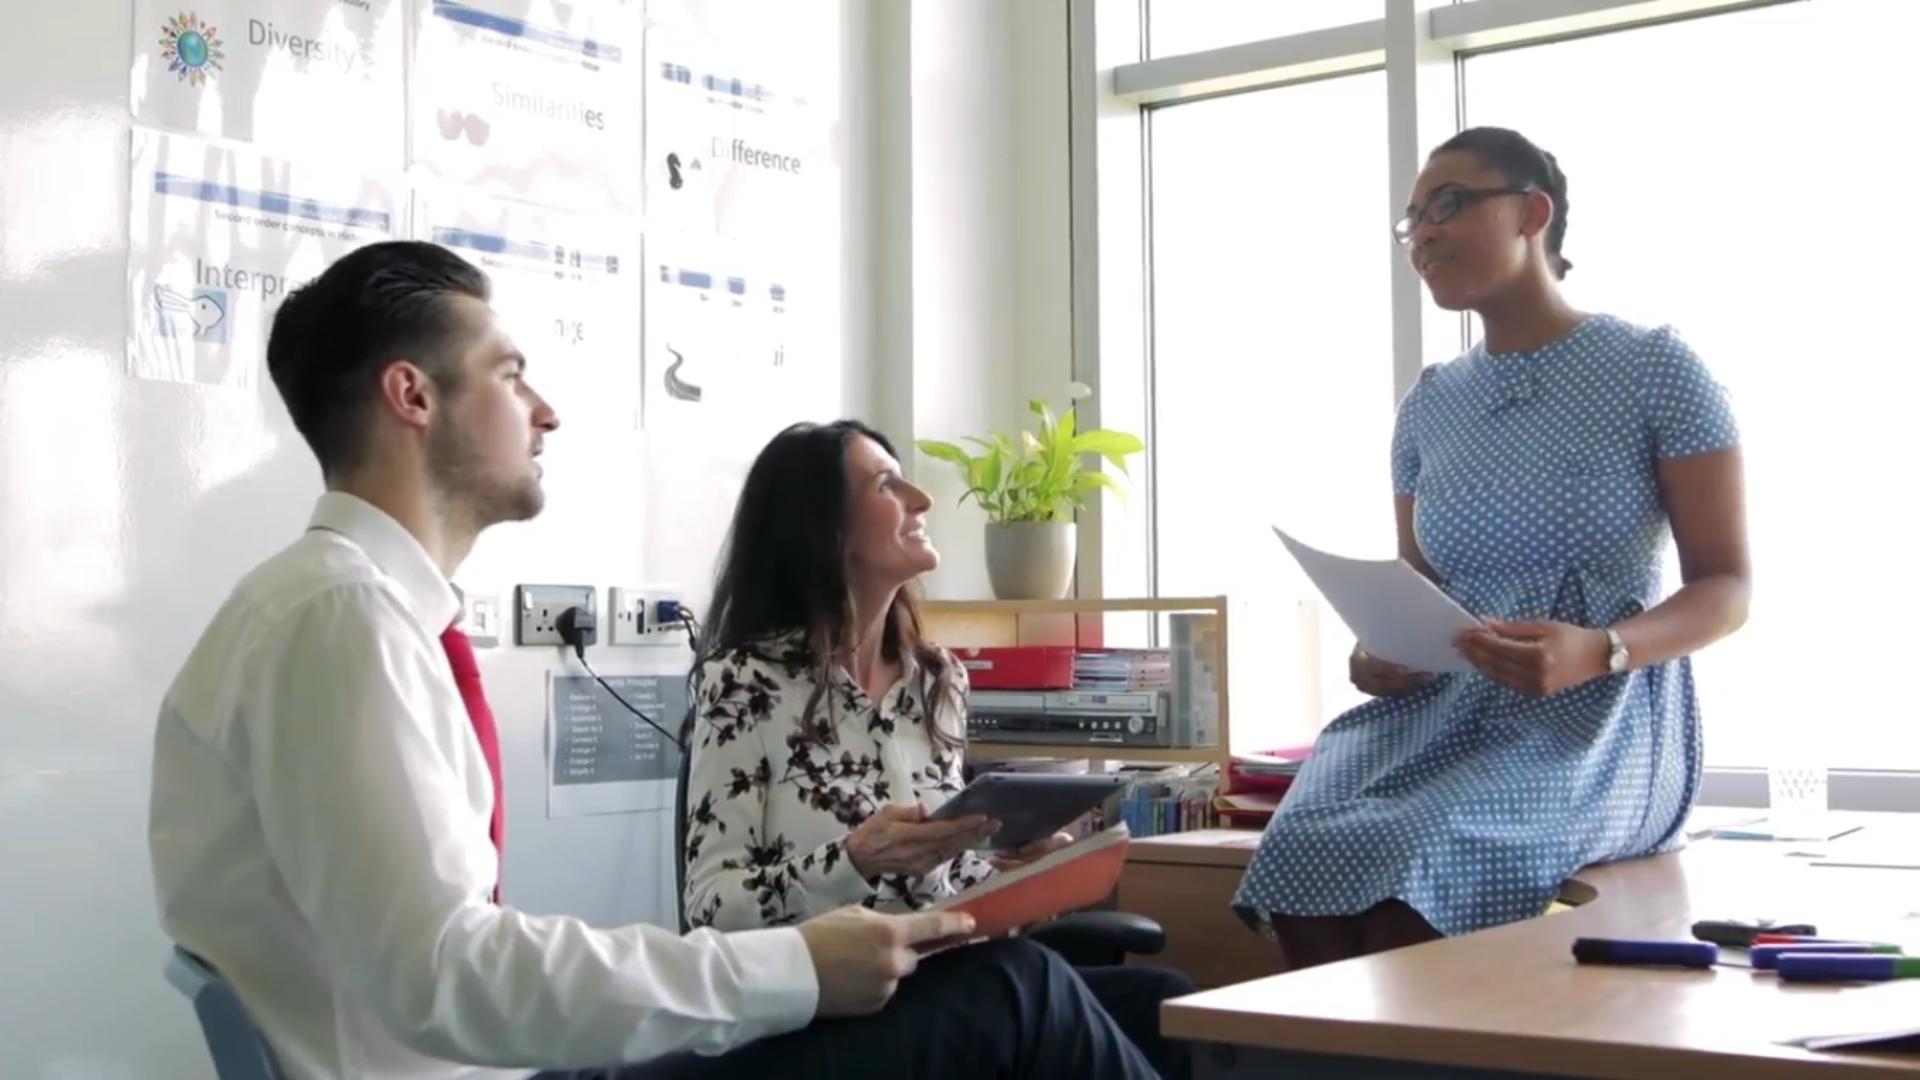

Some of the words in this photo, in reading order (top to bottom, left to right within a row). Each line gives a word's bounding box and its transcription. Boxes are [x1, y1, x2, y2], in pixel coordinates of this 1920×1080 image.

[247, 18, 357, 75] Diversity
[491, 80, 606, 132] Similarities
[711, 136, 802, 176] Difference
